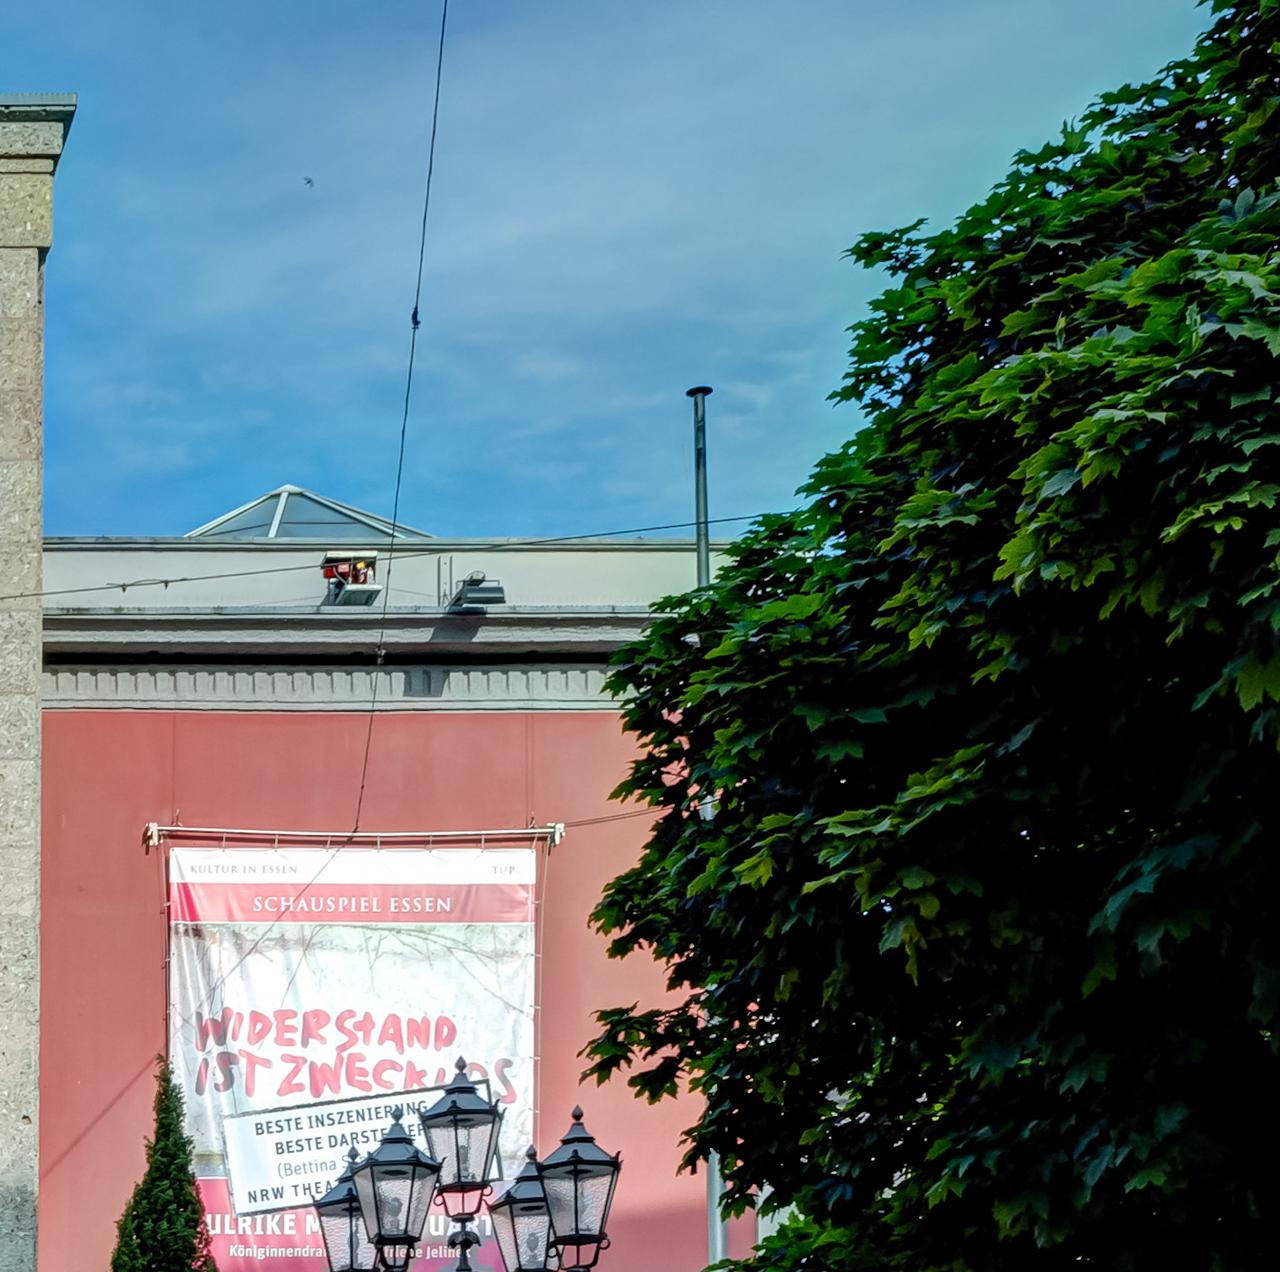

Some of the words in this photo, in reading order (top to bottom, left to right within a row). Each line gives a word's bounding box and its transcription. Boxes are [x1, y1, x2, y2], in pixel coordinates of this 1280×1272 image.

[190, 864, 238, 874] KULTUR
[243, 864, 256, 874] IN
[253, 896, 382, 913] SCHAUSPIEL
[390, 896, 452, 913] ESSEN
[195, 1049, 274, 1098] IST
[255, 1117, 303, 1136] BESTE
[275, 1137, 323, 1156] BESTE
[248, 1186, 285, 1204] NRW
